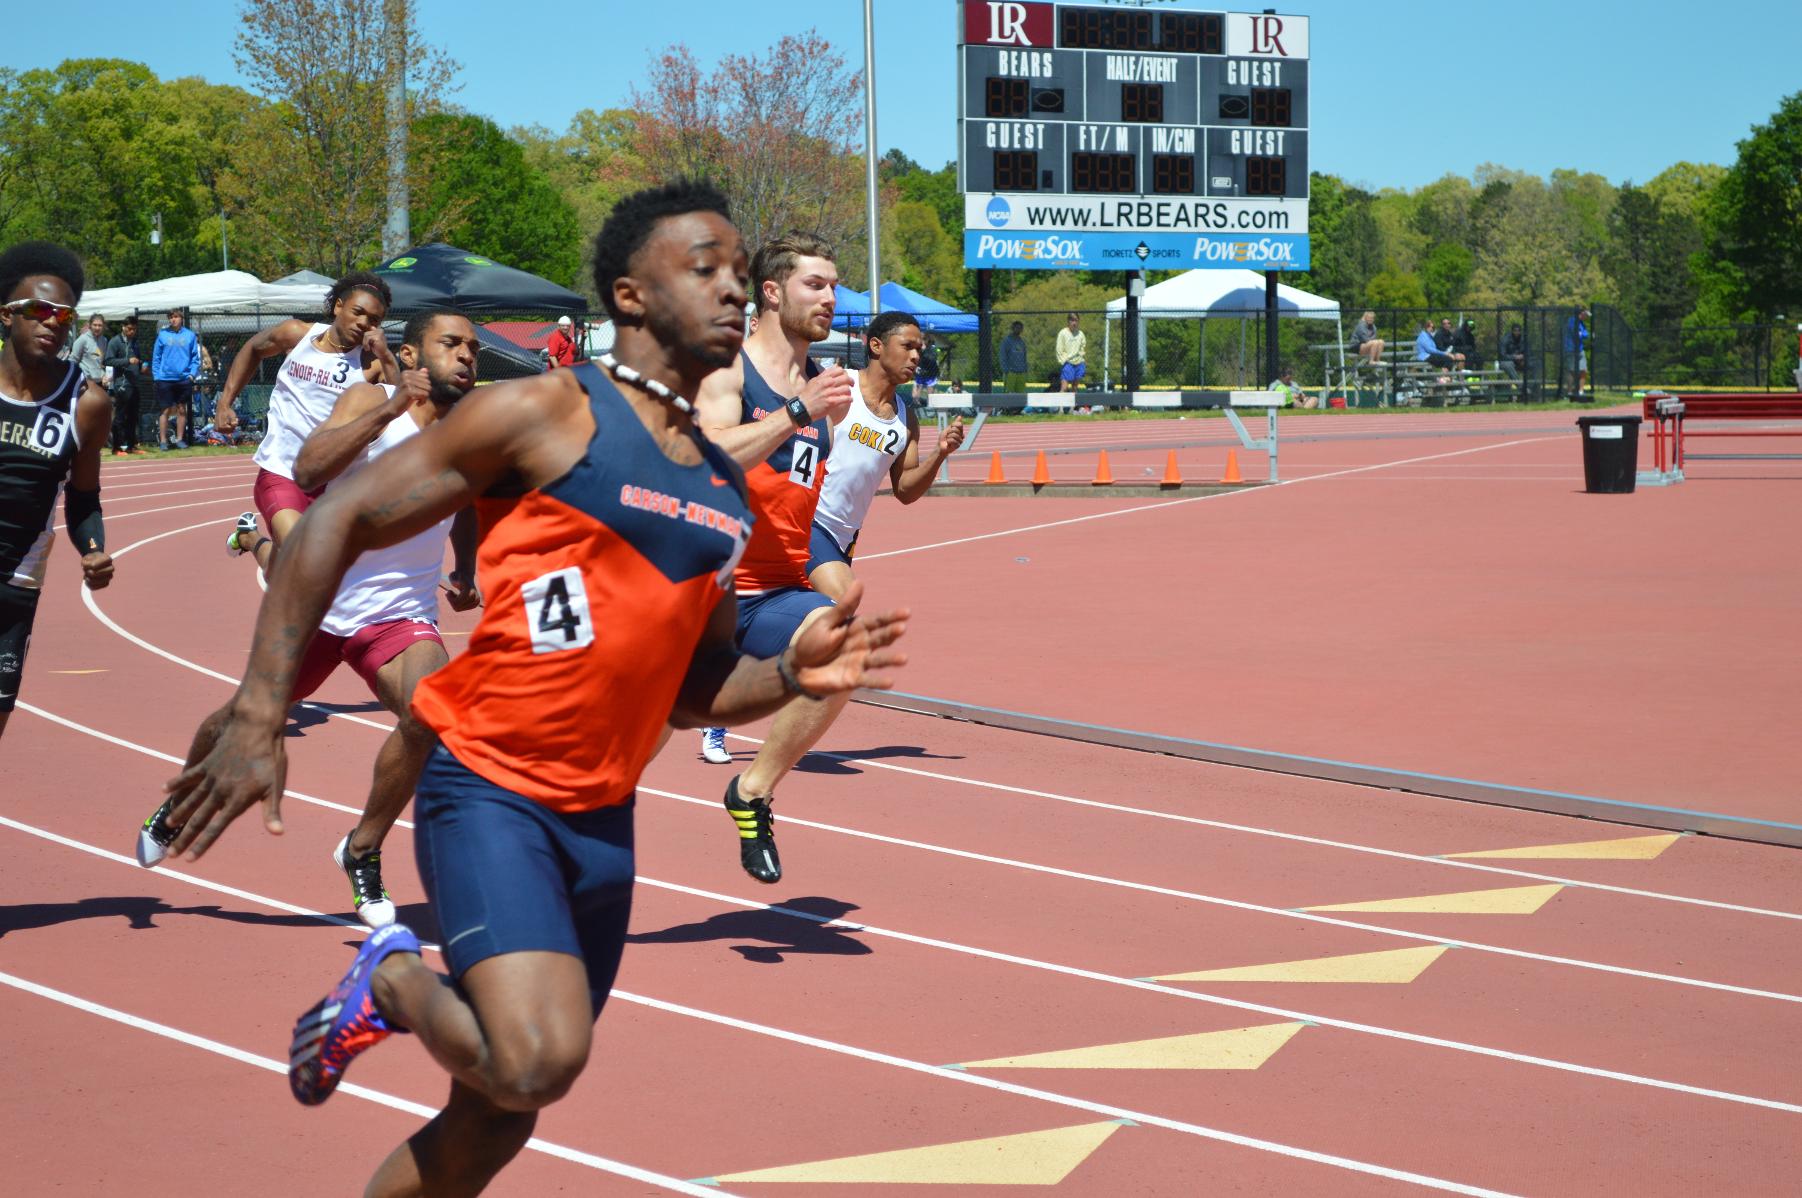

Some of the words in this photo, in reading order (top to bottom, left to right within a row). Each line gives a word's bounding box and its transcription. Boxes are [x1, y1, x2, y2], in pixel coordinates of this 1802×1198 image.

[999, 51, 1053, 77] BEARS
[1107, 56, 1178, 82] HALF/EVENT
[1228, 61, 1281, 86] GUEST
[986, 123, 1045, 149] GUEST
[1152, 128, 1195, 153] IN/CM
[1231, 130, 1285, 155] GUEST
[1027, 202, 1289, 229] www.LRBEARS.com
[1102, 249, 1133, 258] MORETZ
[1152, 249, 1180, 258] SPORTS
[332, 361, 350, 384] 3
[36, 411, 64, 448] 6
[884, 428, 900, 456] 2
[794, 446, 814, 484] 4
[538, 575, 581, 642] 4
